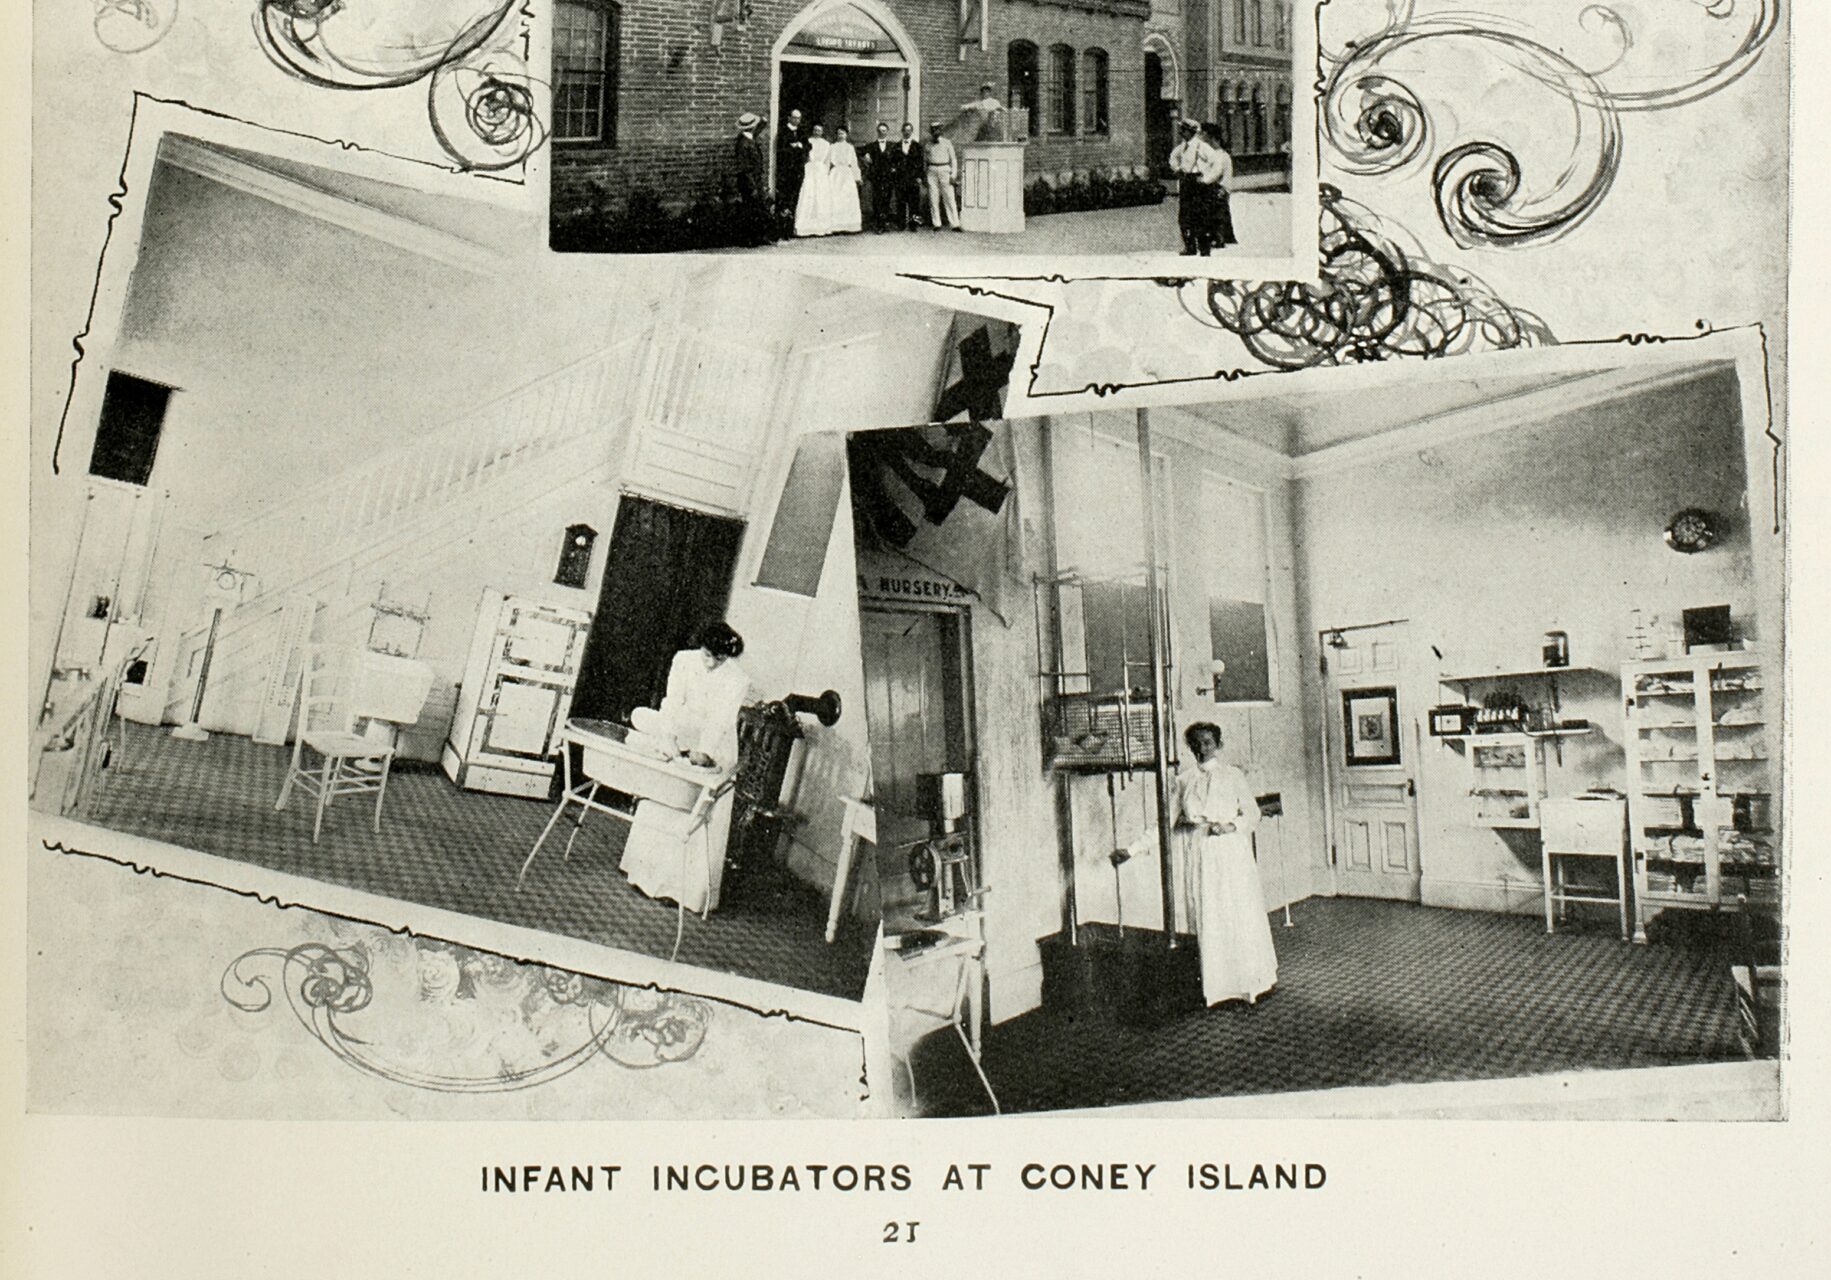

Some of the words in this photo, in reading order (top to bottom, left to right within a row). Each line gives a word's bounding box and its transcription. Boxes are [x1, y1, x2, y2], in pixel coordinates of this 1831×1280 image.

[482, 1165, 621, 1193] INFANT
[653, 1164, 911, 1192] INCUBATORS
[942, 1164, 990, 1191] AT
[1020, 1163, 1155, 1190] CONEY
[1188, 1163, 1327, 1190] ISLAND
[882, 1221, 920, 1243] 21
